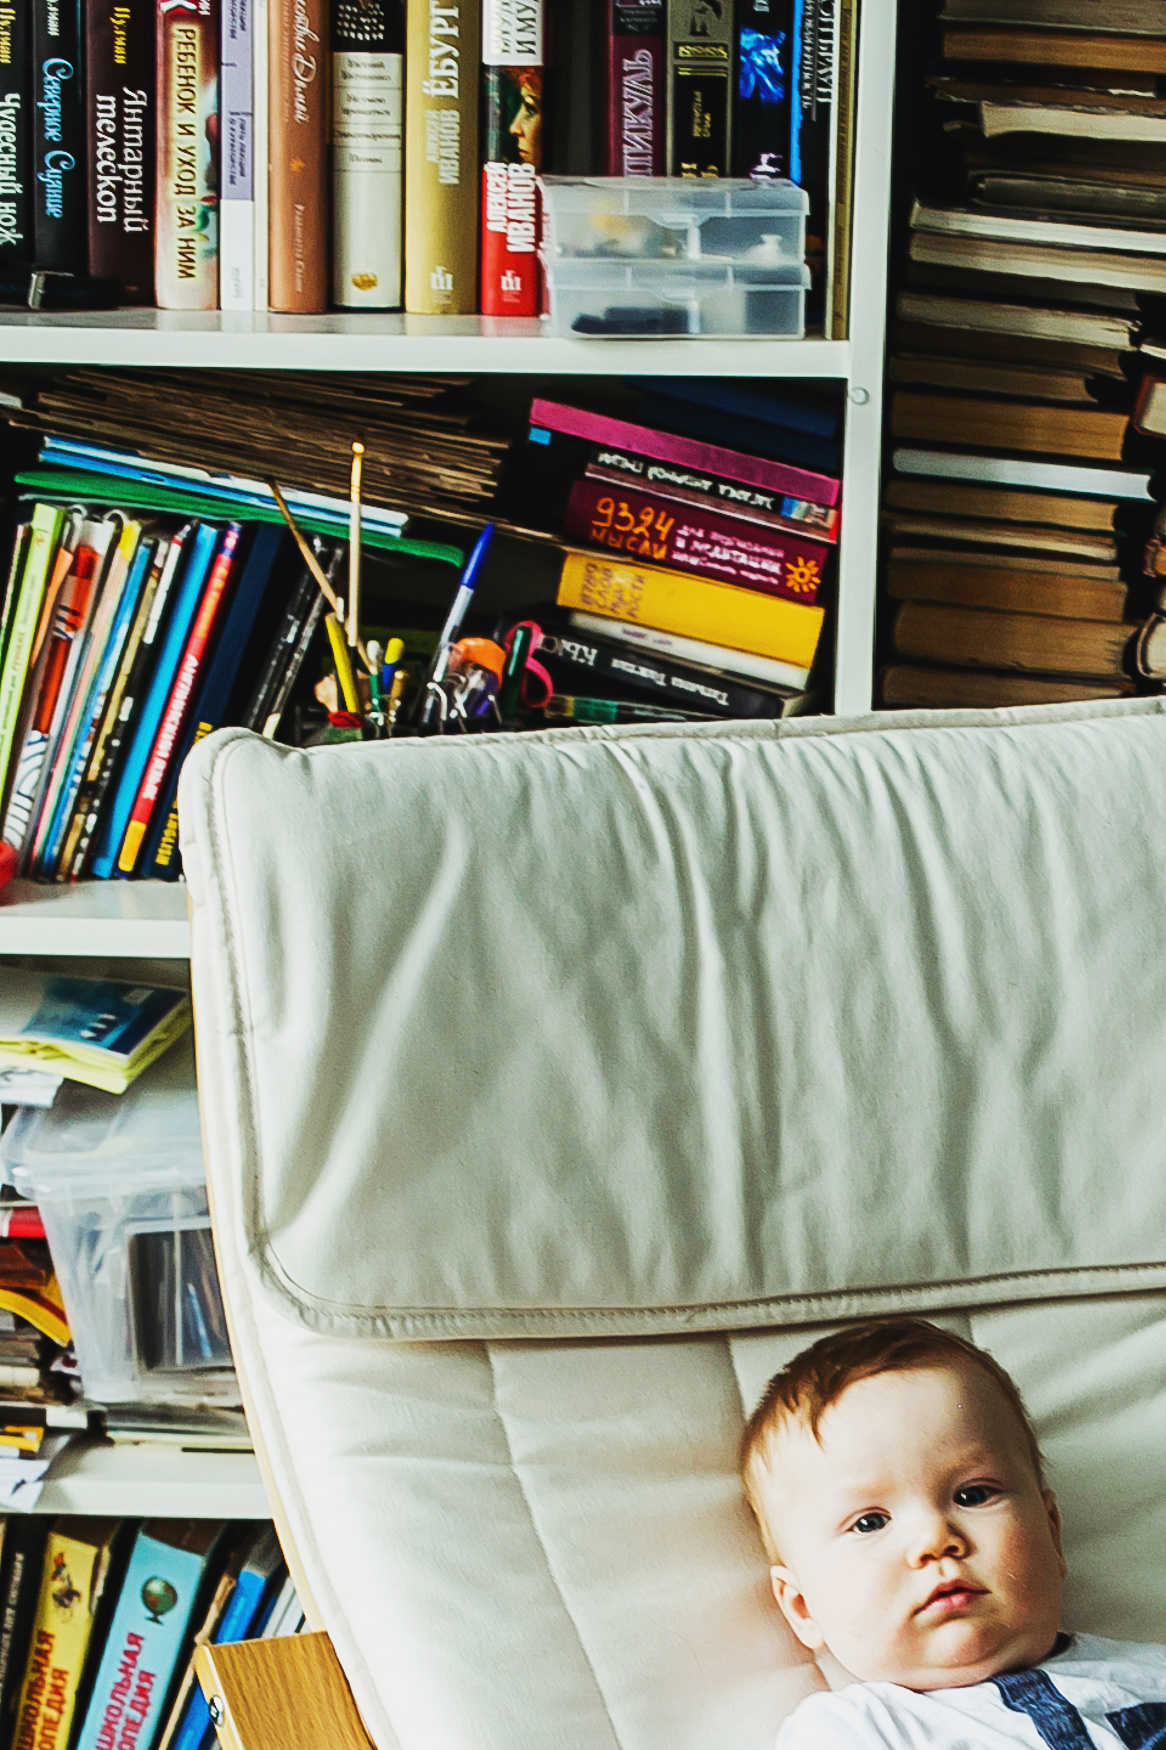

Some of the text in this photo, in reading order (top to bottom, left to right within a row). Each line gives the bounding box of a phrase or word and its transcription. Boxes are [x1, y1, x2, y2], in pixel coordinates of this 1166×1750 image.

[421, 0, 461, 99] ЁБУРГ
[37, 58, 76, 219] Северное Сияние
[96, 94, 122, 223] телескоп
[118, 86, 149, 233] Янтарный
[174, 27, 197, 280] РЕБЕНОК И УХОД ЗА НИМ
[438, 108, 460, 185] ИВАНОВ
[622, 48, 654, 177] ПИКУЛЬ
[0, 93, 24, 246] Чудесный нож
[483, 162, 508, 233] АЛЕКСЕЙ
[506, 162, 536, 253] ИВАНОВ
[590, 527, 668, 561] МЫСЛИ
[592, 497, 675, 542] 9324
[540, 633, 598, 667] КЫС
